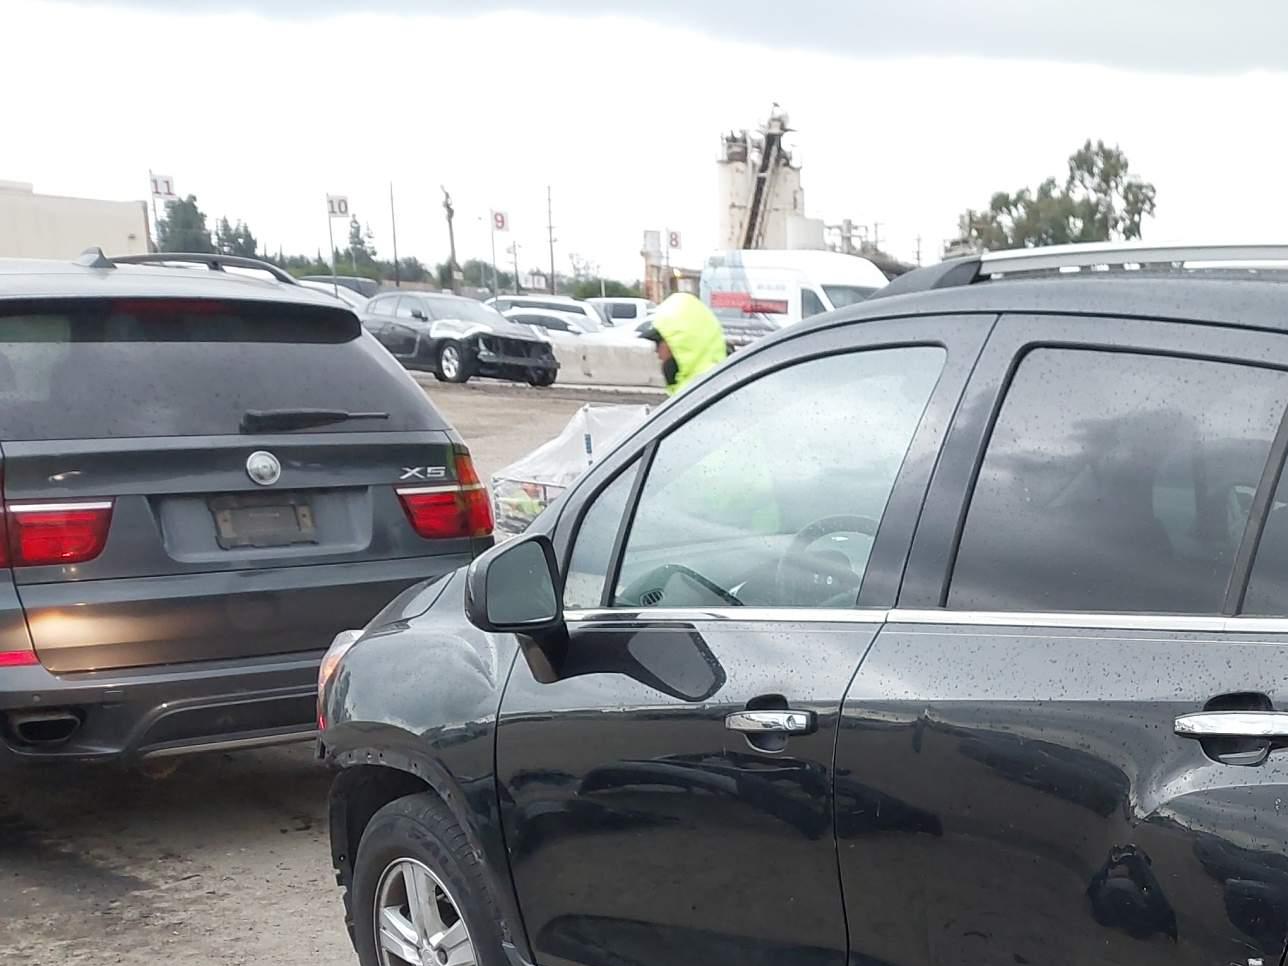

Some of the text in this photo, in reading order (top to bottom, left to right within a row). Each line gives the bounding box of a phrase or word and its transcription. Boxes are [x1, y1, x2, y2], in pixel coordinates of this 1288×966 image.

[151, 179, 176, 196] 11
[328, 199, 348, 215] 10
[494, 212, 505, 230] 9
[669, 231, 679, 248] 8
[400, 466, 446, 479] X5
